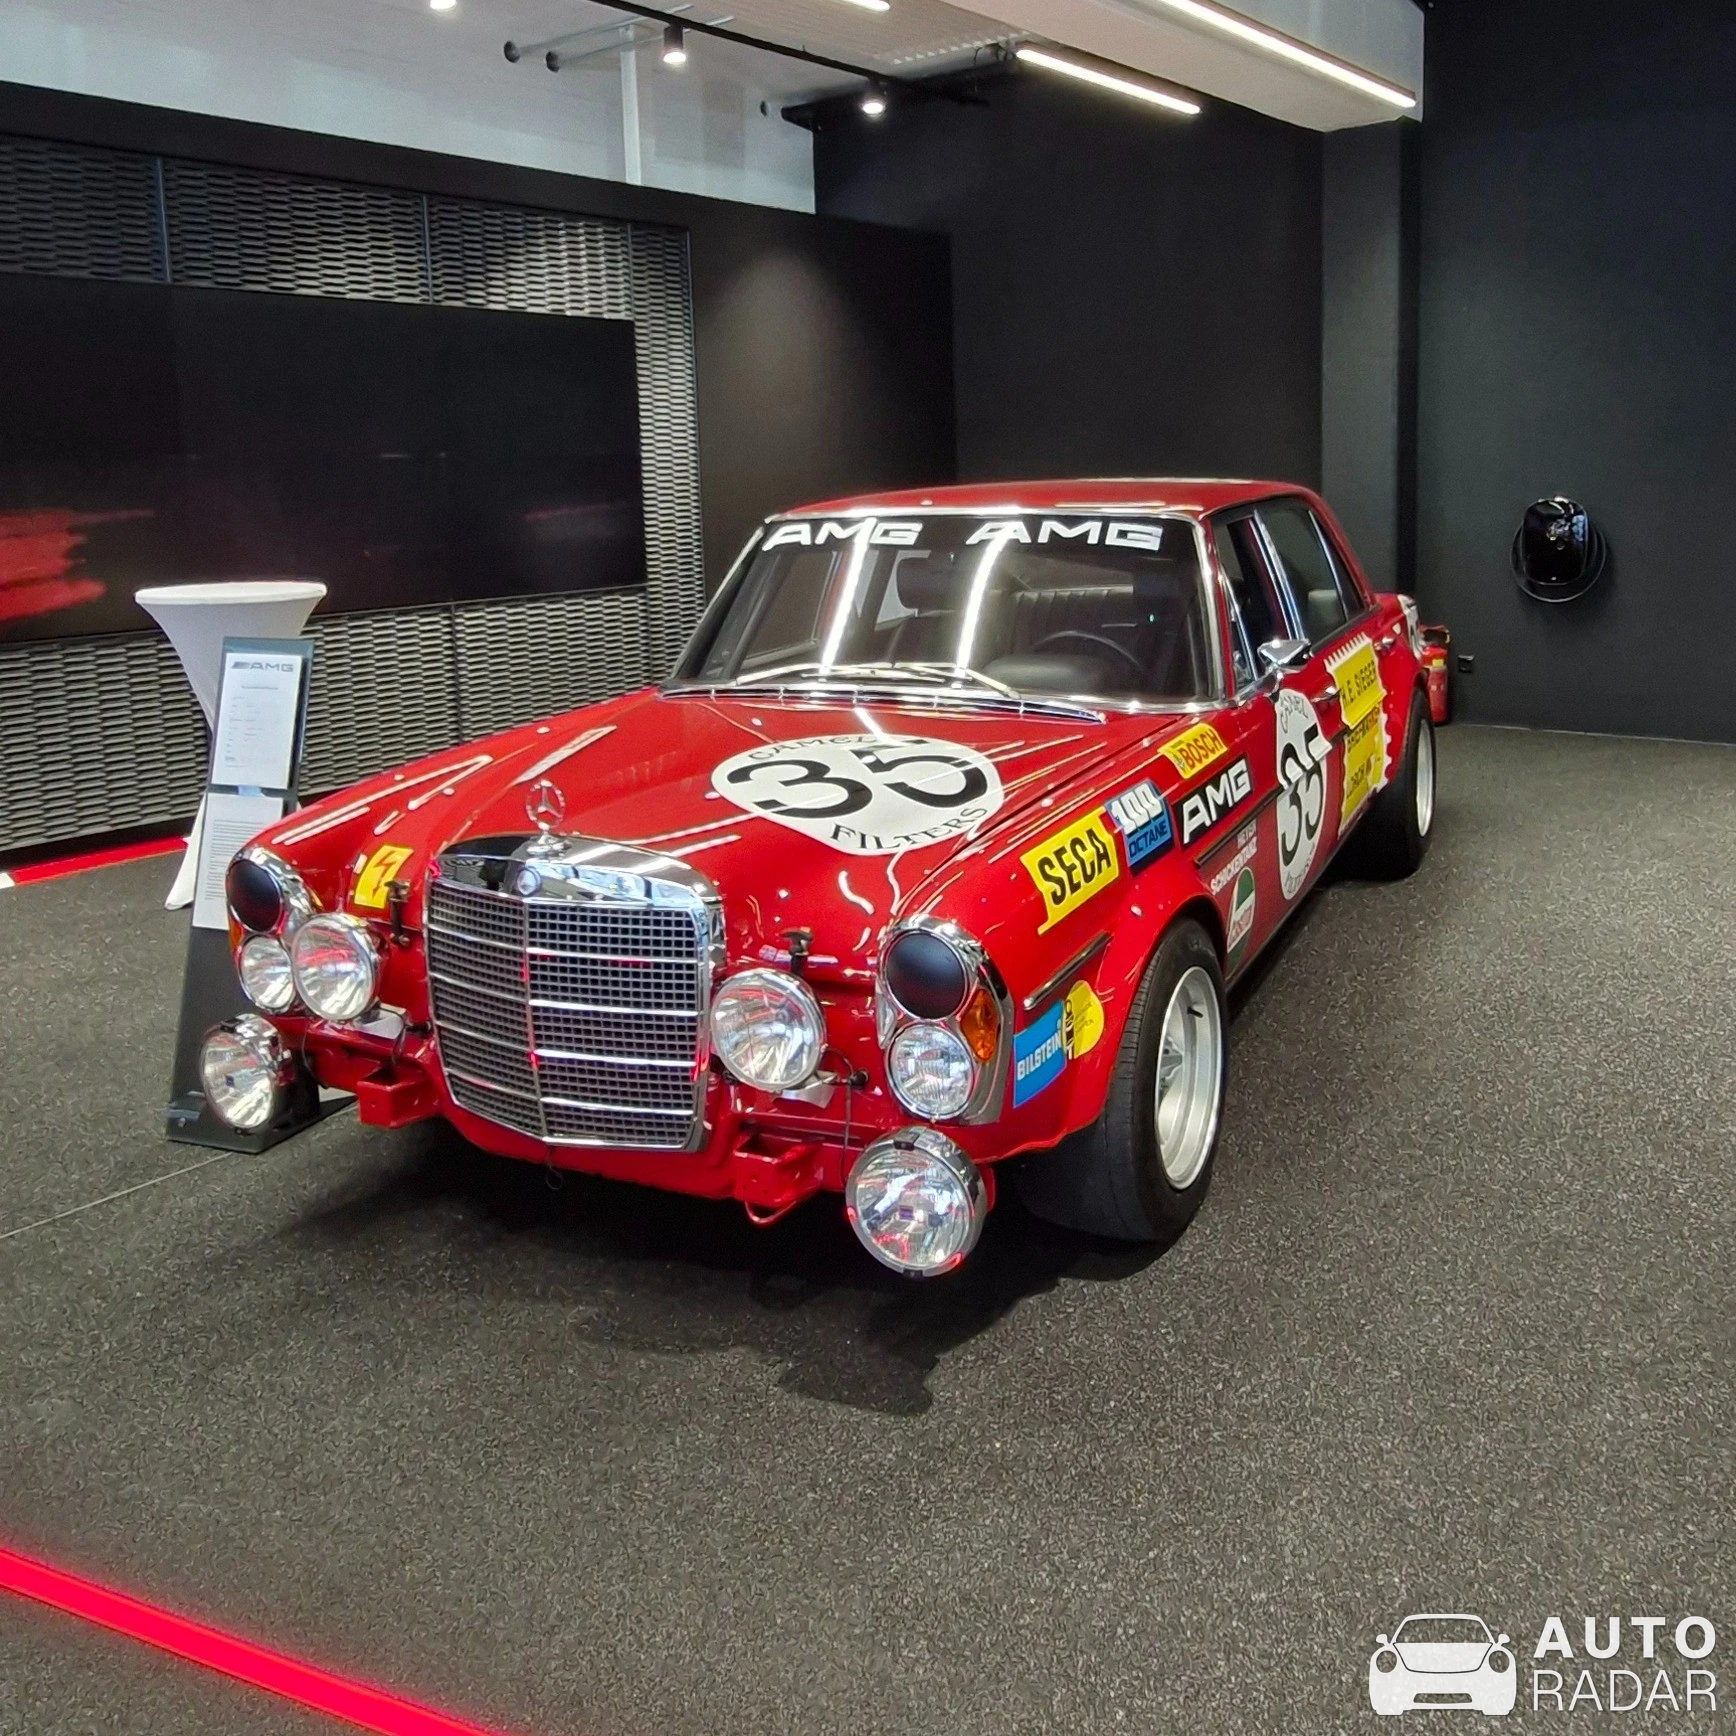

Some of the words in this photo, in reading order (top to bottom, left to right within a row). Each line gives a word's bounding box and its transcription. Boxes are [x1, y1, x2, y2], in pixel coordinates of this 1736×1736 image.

[763, 521, 923, 551] AMG
[965, 521, 1163, 551] AMG
[250, 662, 294, 673] AMG
[1177, 728, 1223, 771] BOSCH
[727, 739, 988, 819] 35
[1182, 758, 1252, 845] AMG
[1281, 722, 1324, 867] 35
[830, 806, 988, 850] FILTERS
[1110, 783, 1163, 835] 100
[1128, 819, 1168, 859] OCTANE
[1037, 828, 1112, 906] SECA
[1017, 1029, 1062, 1081] BILSTEIN
